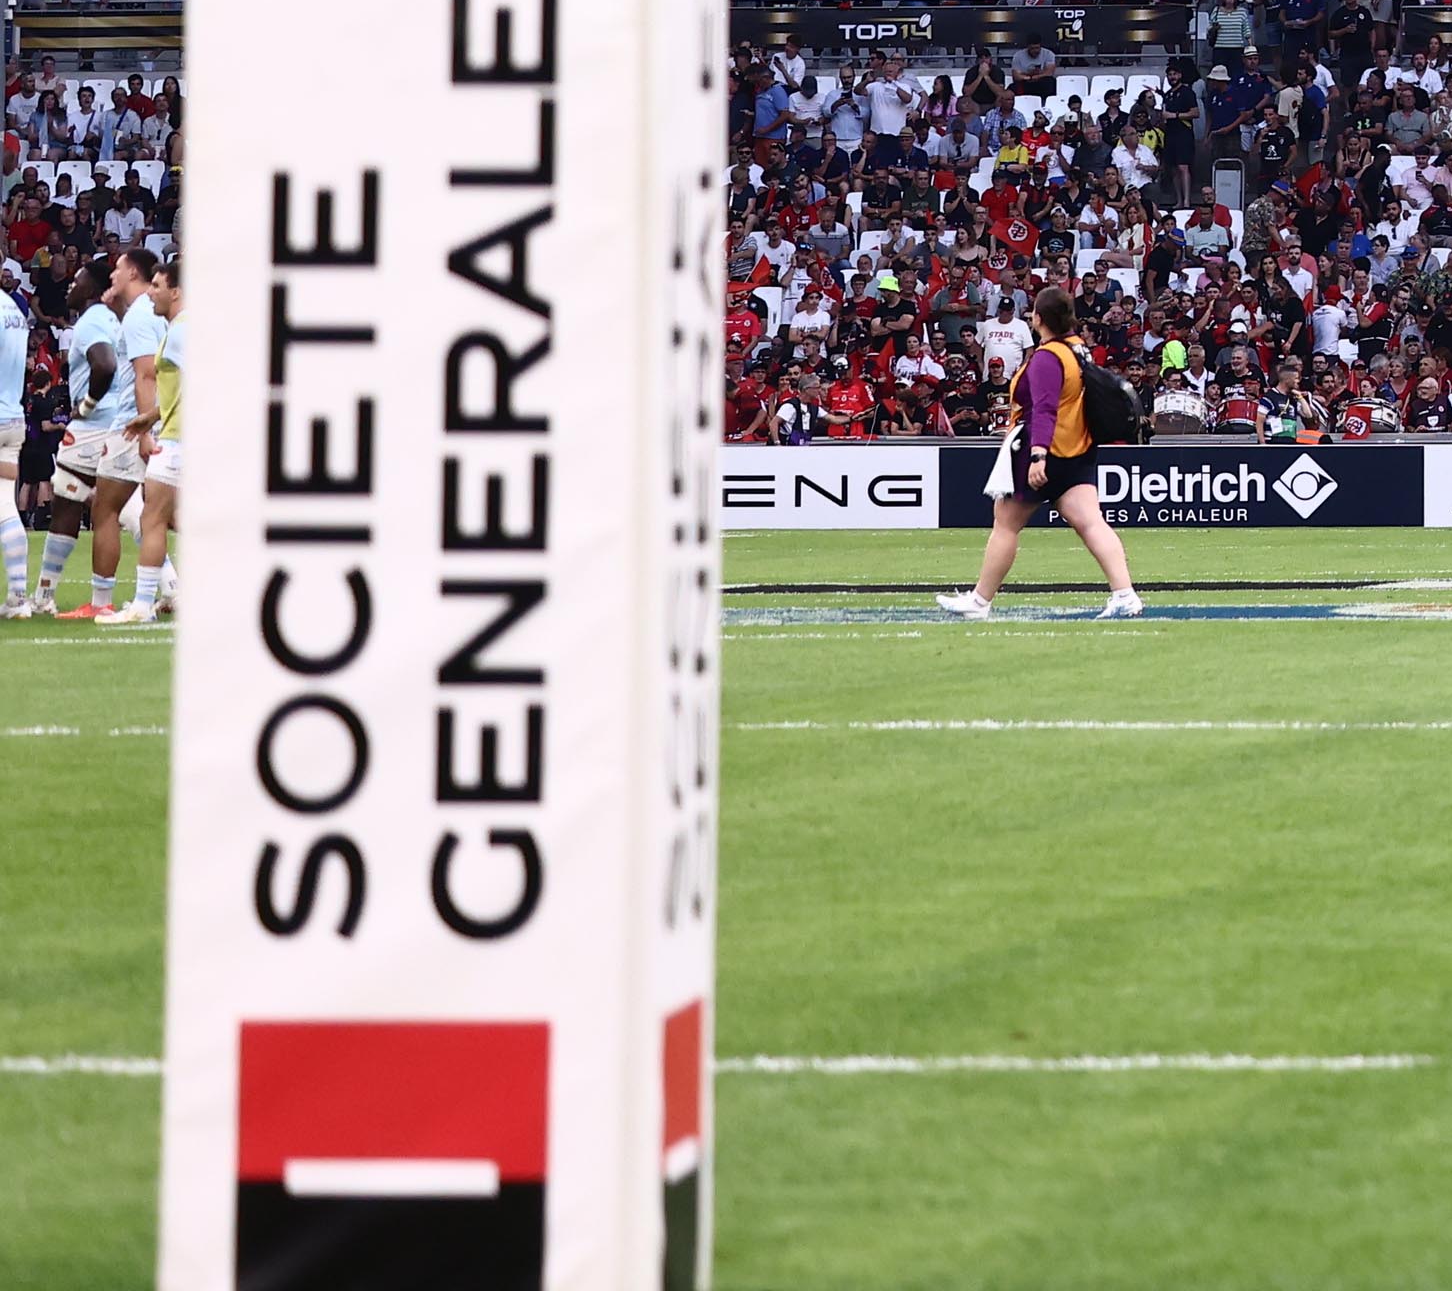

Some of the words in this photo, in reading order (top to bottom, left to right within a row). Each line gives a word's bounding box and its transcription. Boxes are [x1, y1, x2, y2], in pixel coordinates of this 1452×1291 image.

[1054, 9, 1086, 19] TOP
[838, 24, 933, 41] TOP14
[1055, 27, 1084, 41] 14
[988, 330, 1015, 340] STADE
[1097, 463, 1266, 504] Dietrich
[1137, 506, 1149, 522] À
[1157, 508, 1249, 522] CHALEUR
[254, 168, 382, 940] SOCIETE
